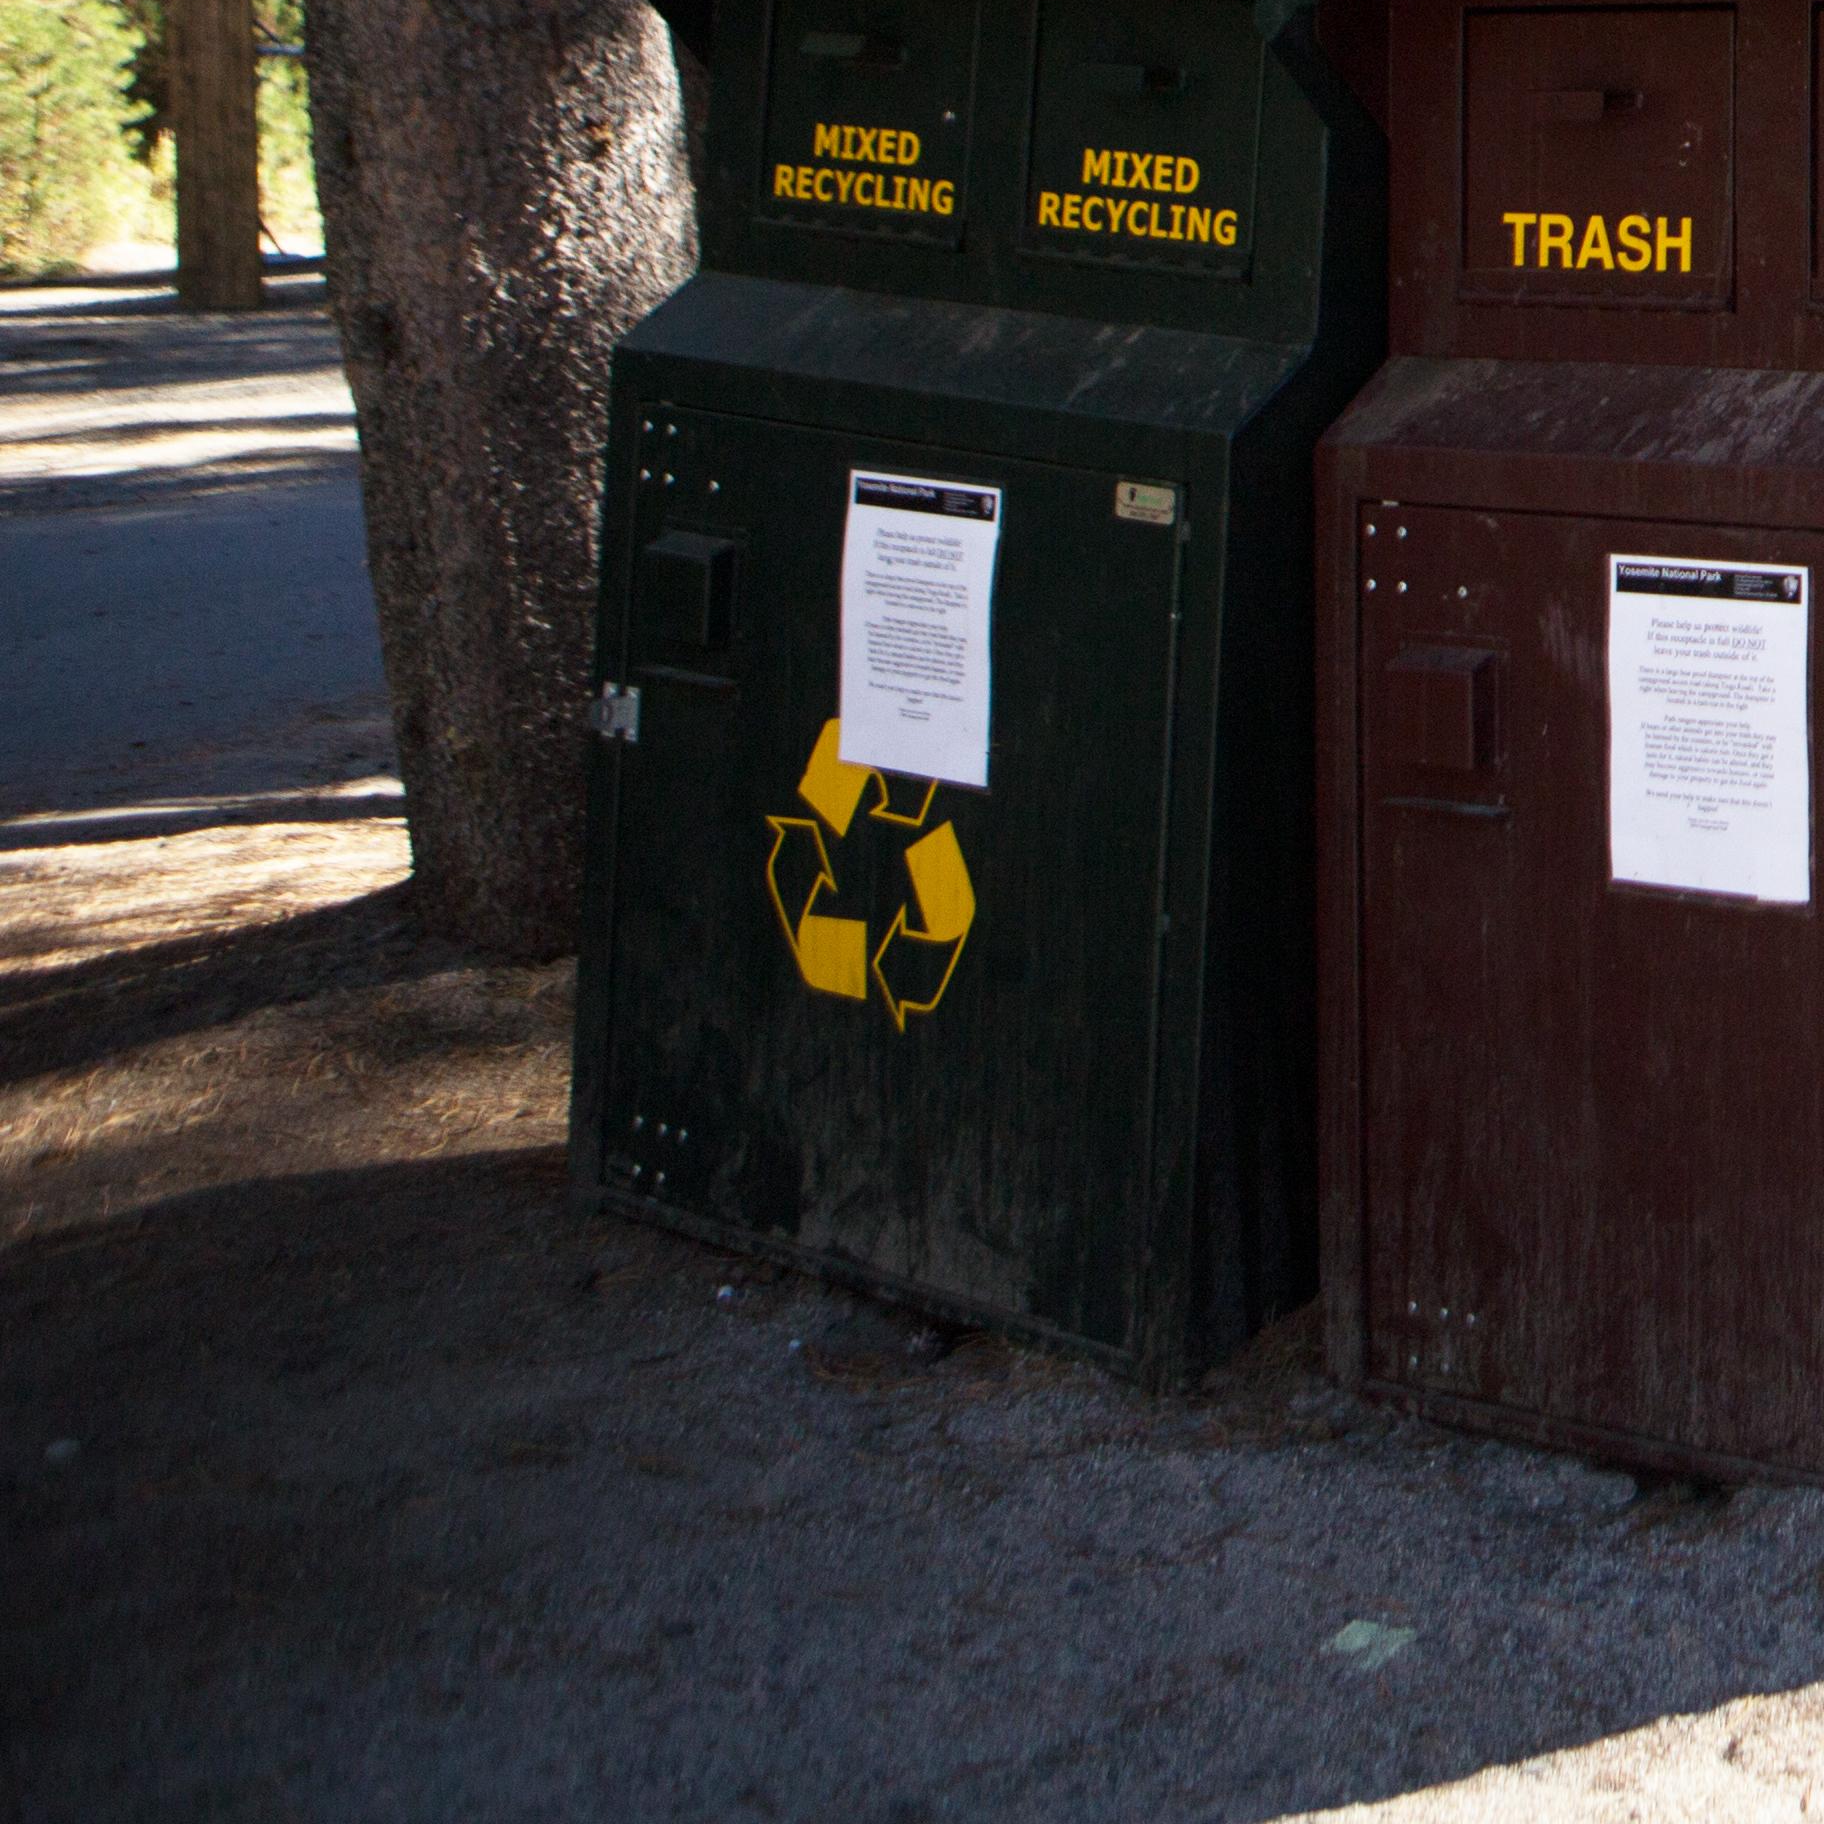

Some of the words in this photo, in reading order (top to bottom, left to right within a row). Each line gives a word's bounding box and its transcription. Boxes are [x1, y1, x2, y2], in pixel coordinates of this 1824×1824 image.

[815, 124, 919, 164] MIXED
[775, 165, 953, 214] RECYCLING
[1083, 149, 1198, 192] MIXED
[1039, 192, 1236, 245] RECYCLING
[1503, 213, 1691, 272] TRASH
[1618, 565, 1660, 578] Yosemite
[1662, 567, 1699, 581] National
[1700, 570, 1722, 582] Park
